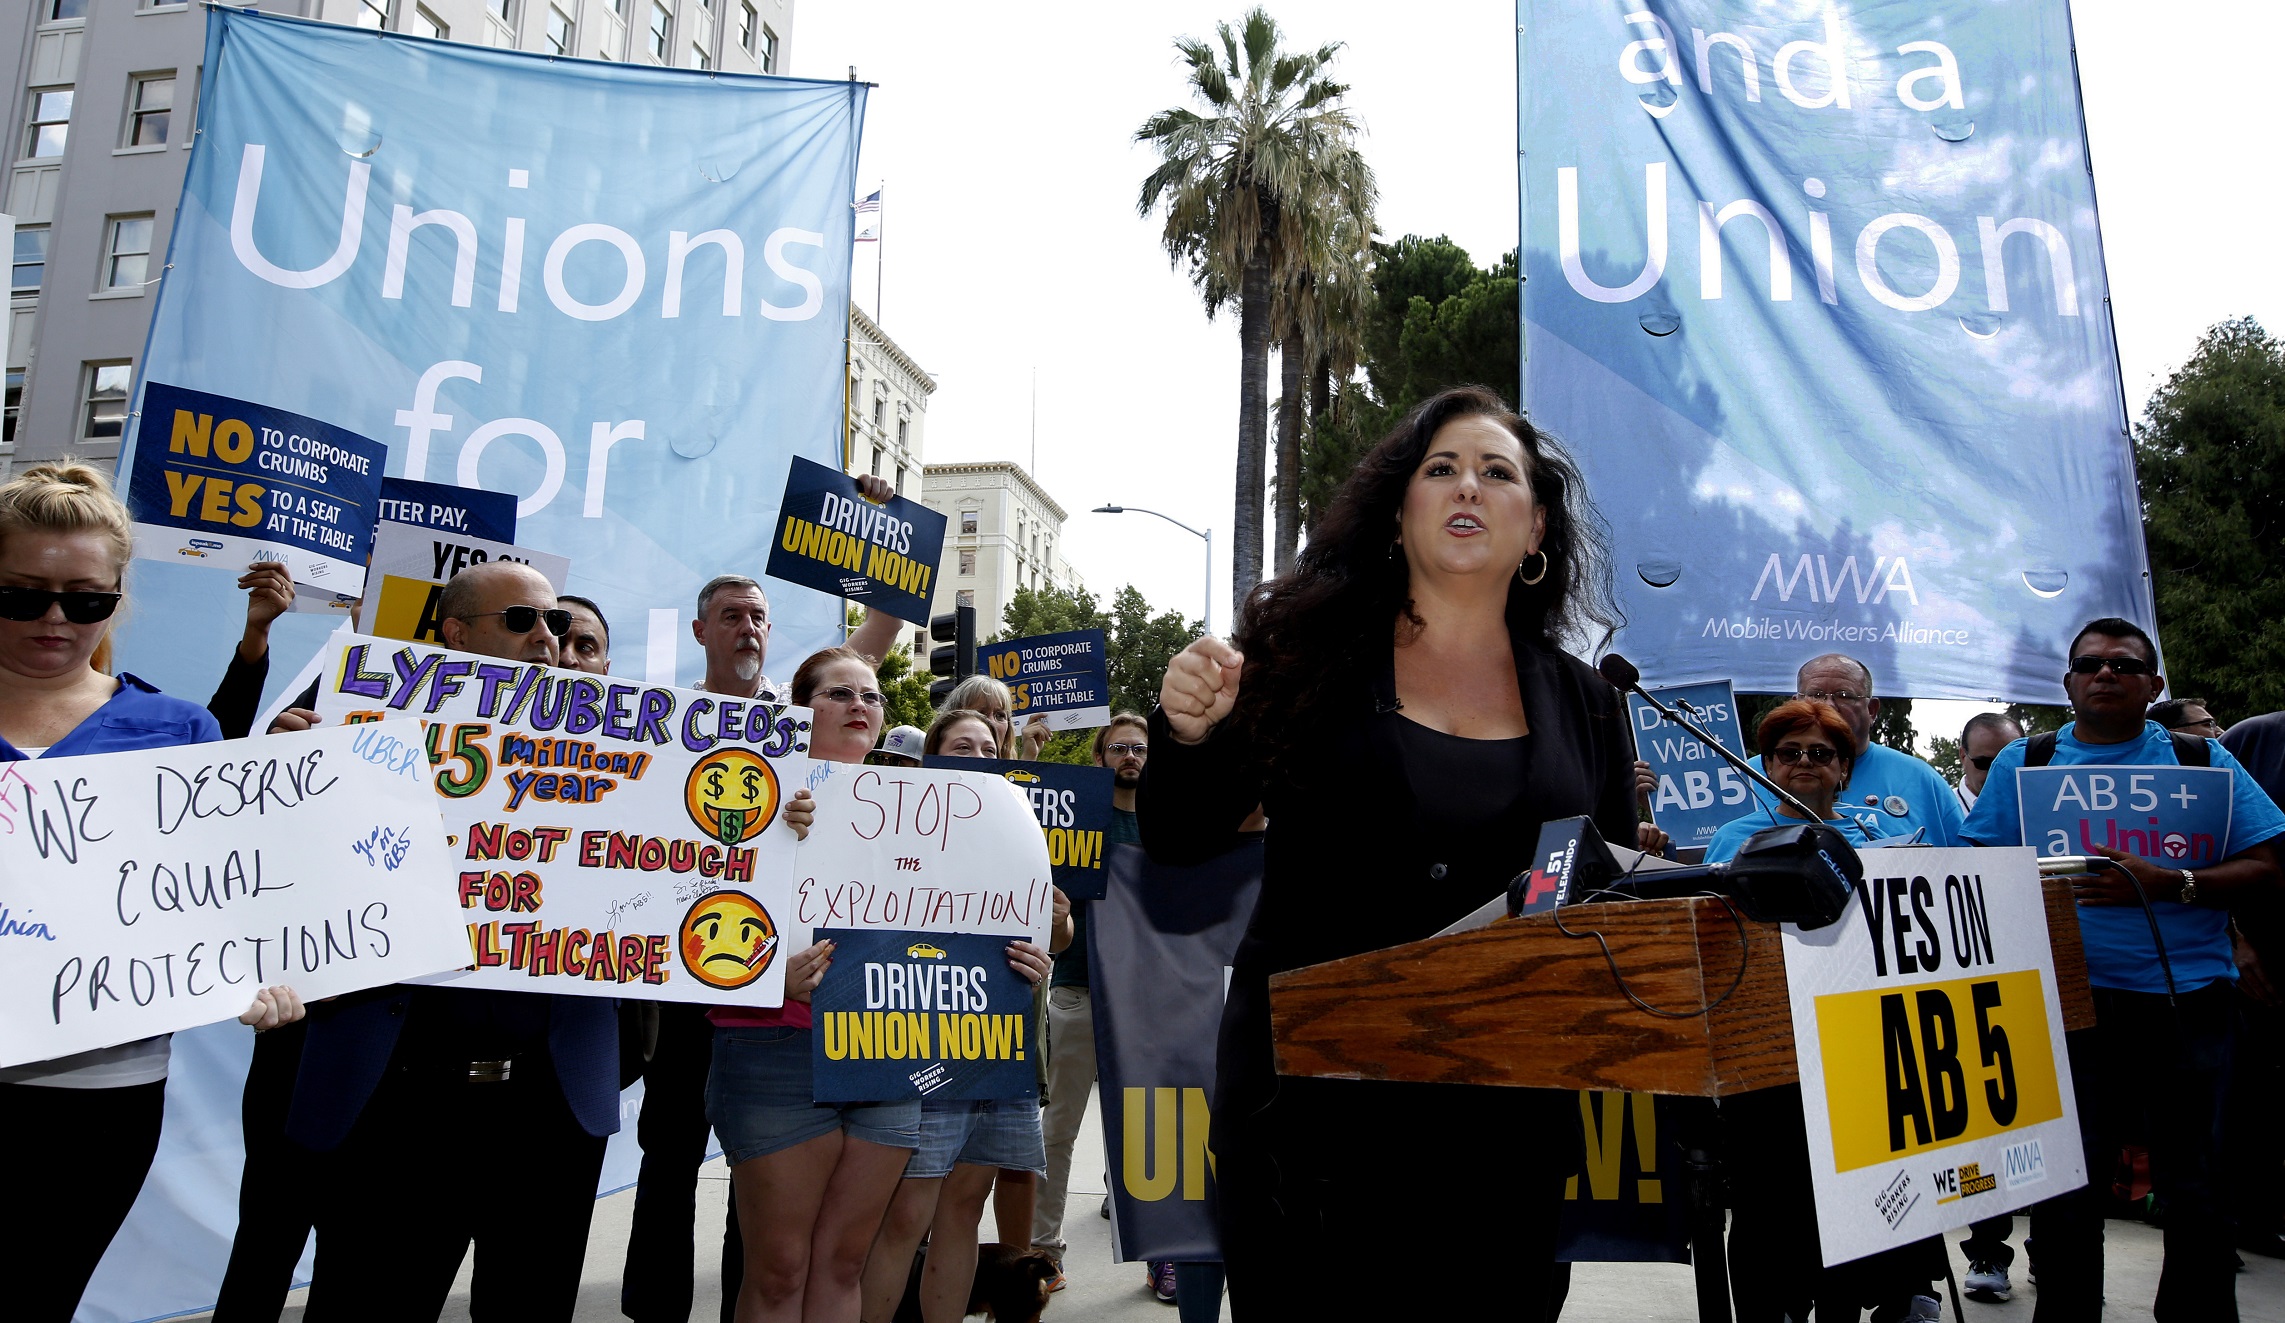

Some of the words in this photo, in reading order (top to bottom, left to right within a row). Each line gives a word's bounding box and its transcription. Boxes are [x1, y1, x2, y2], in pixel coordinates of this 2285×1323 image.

[1619, 9, 1852, 109] and
[1896, 40, 1965, 112] a
[230, 143, 824, 322] Unions
[1557, 161, 2079, 317] Union
[169, 409, 254, 464] NO
[261, 427, 285, 450] TO
[288, 433, 370, 477] CORPORATE
[395, 360, 645, 519] for
[258, 450, 328, 485] CRUMBS
[164, 471, 266, 529] YES
[270, 489, 292, 512] TO
[295, 494, 309, 515] A
[311, 497, 341, 523] SEAT
[430, 504, 469, 531] PAY,
[267, 511, 287, 533] AT
[292, 516, 316, 544] THE
[318, 522, 354, 554] TABLE
[820, 492, 913, 554] DRIVERS
[253, 550, 289, 566] MWA
[781, 516, 864, 572] UNION
[867, 545, 931, 599] NOW!
[1750, 553, 1919, 605] MWA
[841, 580, 868, 588] WORKERS
[1021, 649, 1032, 660] TO
[1035, 642, 1092, 659] CORPORATE
[1702, 617, 1781, 639] Mobile
[1784, 619, 1878, 642] Workers
[1880, 622, 1969, 645] Alliance
[988, 651, 1020, 679] NO
[1022, 659, 1062, 673] CRUMBS
[1031, 682, 1042, 693] TO
[1046, 681, 1053, 692] A
[1055, 678, 1077, 691] SEAT
[335, 643, 676, 745] LYFT/UBER
[1032, 696, 1043, 707] AT
[1045, 693, 1063, 706] THE
[1065, 690, 1094, 704] TABLE
[352, 727, 419, 782] UBER
[23, 777, 113, 864] WE
[156, 749, 339, 835] DESERVE
[503, 768, 618, 812] year
[851, 771, 982, 851] STOP
[1655, 769, 1715, 812] AB
[2052, 774, 2118, 812] AB
[2130, 774, 2158, 812] 5
[2170, 784, 2198, 809] +
[465, 821, 567, 864] NOT
[578, 830, 759, 882] ENOUGH
[1042, 827, 1103, 870] OW!
[1696, 825, 1718, 836] MWA
[2047, 828, 2070, 856] a
[2079, 816, 2215, 861] Union
[895, 857, 922, 872] THE
[1546, 850, 1565, 873] 51
[117, 849, 294, 927] EQUAL
[459, 871, 542, 913] FOR
[799, 877, 1049, 930] EXPLOITATION!
[1860, 875, 1941, 977] YES
[1944, 874, 1995, 969] ON
[52, 902, 391, 1025] PROTECTIONS
[466, 923, 670, 986] LTHCARE
[864, 962, 988, 1011] DRIVERS
[823, 1011, 930, 1060] UNION
[939, 1014, 1025, 1061] NOW!
[909, 1071, 921, 1081] GIG
[913, 1066, 945, 1087] WORKERS
[918, 1076, 941, 1092] RISING
[1880, 988, 1969, 1153] AB
[1970, 980, 2019, 1127] 5
[1933, 1168, 1957, 1195] WE
[1959, 1164, 1980, 1180] DRIVE
[2006, 1141, 2043, 1178] MWA
[1874, 1189, 1887, 1209] GIG
[1880, 1175, 1911, 1217] WORKERS
[1961, 1175, 1996, 1196] PROGRESS
[1886, 1194, 1909, 1225] RISING
